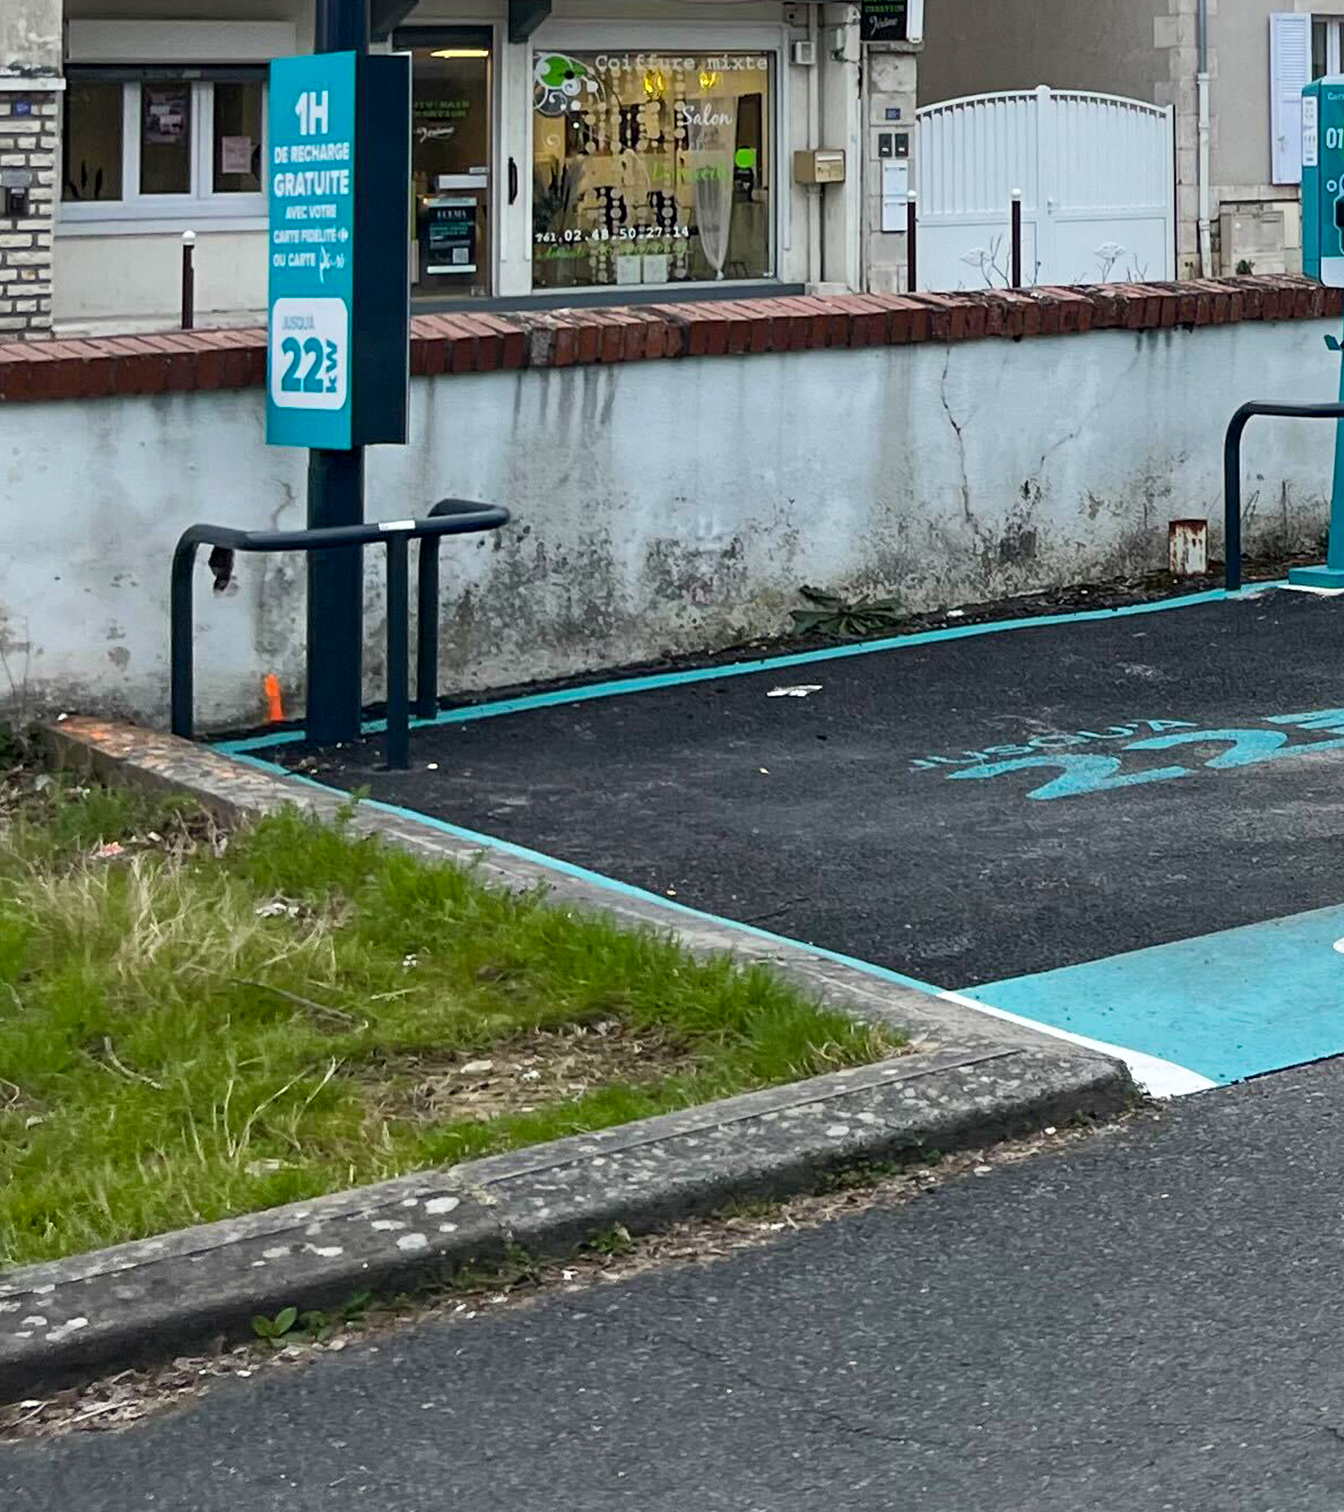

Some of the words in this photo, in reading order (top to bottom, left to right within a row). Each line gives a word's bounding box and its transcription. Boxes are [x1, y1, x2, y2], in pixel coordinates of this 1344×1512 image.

[595, 53, 696, 71] Coiffure
[707, 53, 768, 71] mixte
[295, 90, 329, 137] 1H
[681, 104, 733, 126] Salon
[1326, 127, 1344, 149] 01
[274, 146, 289, 164] DE
[290, 142, 350, 163] RECHARGE
[273, 169, 350, 198] GRATUITE
[285, 205, 308, 219] AVEC
[308, 204, 336, 218] VOTRE
[273, 229, 300, 244] CARTE
[273, 253, 286, 267] OU
[287, 252, 316, 267] CARTE
[281, 336, 324, 393] 22
